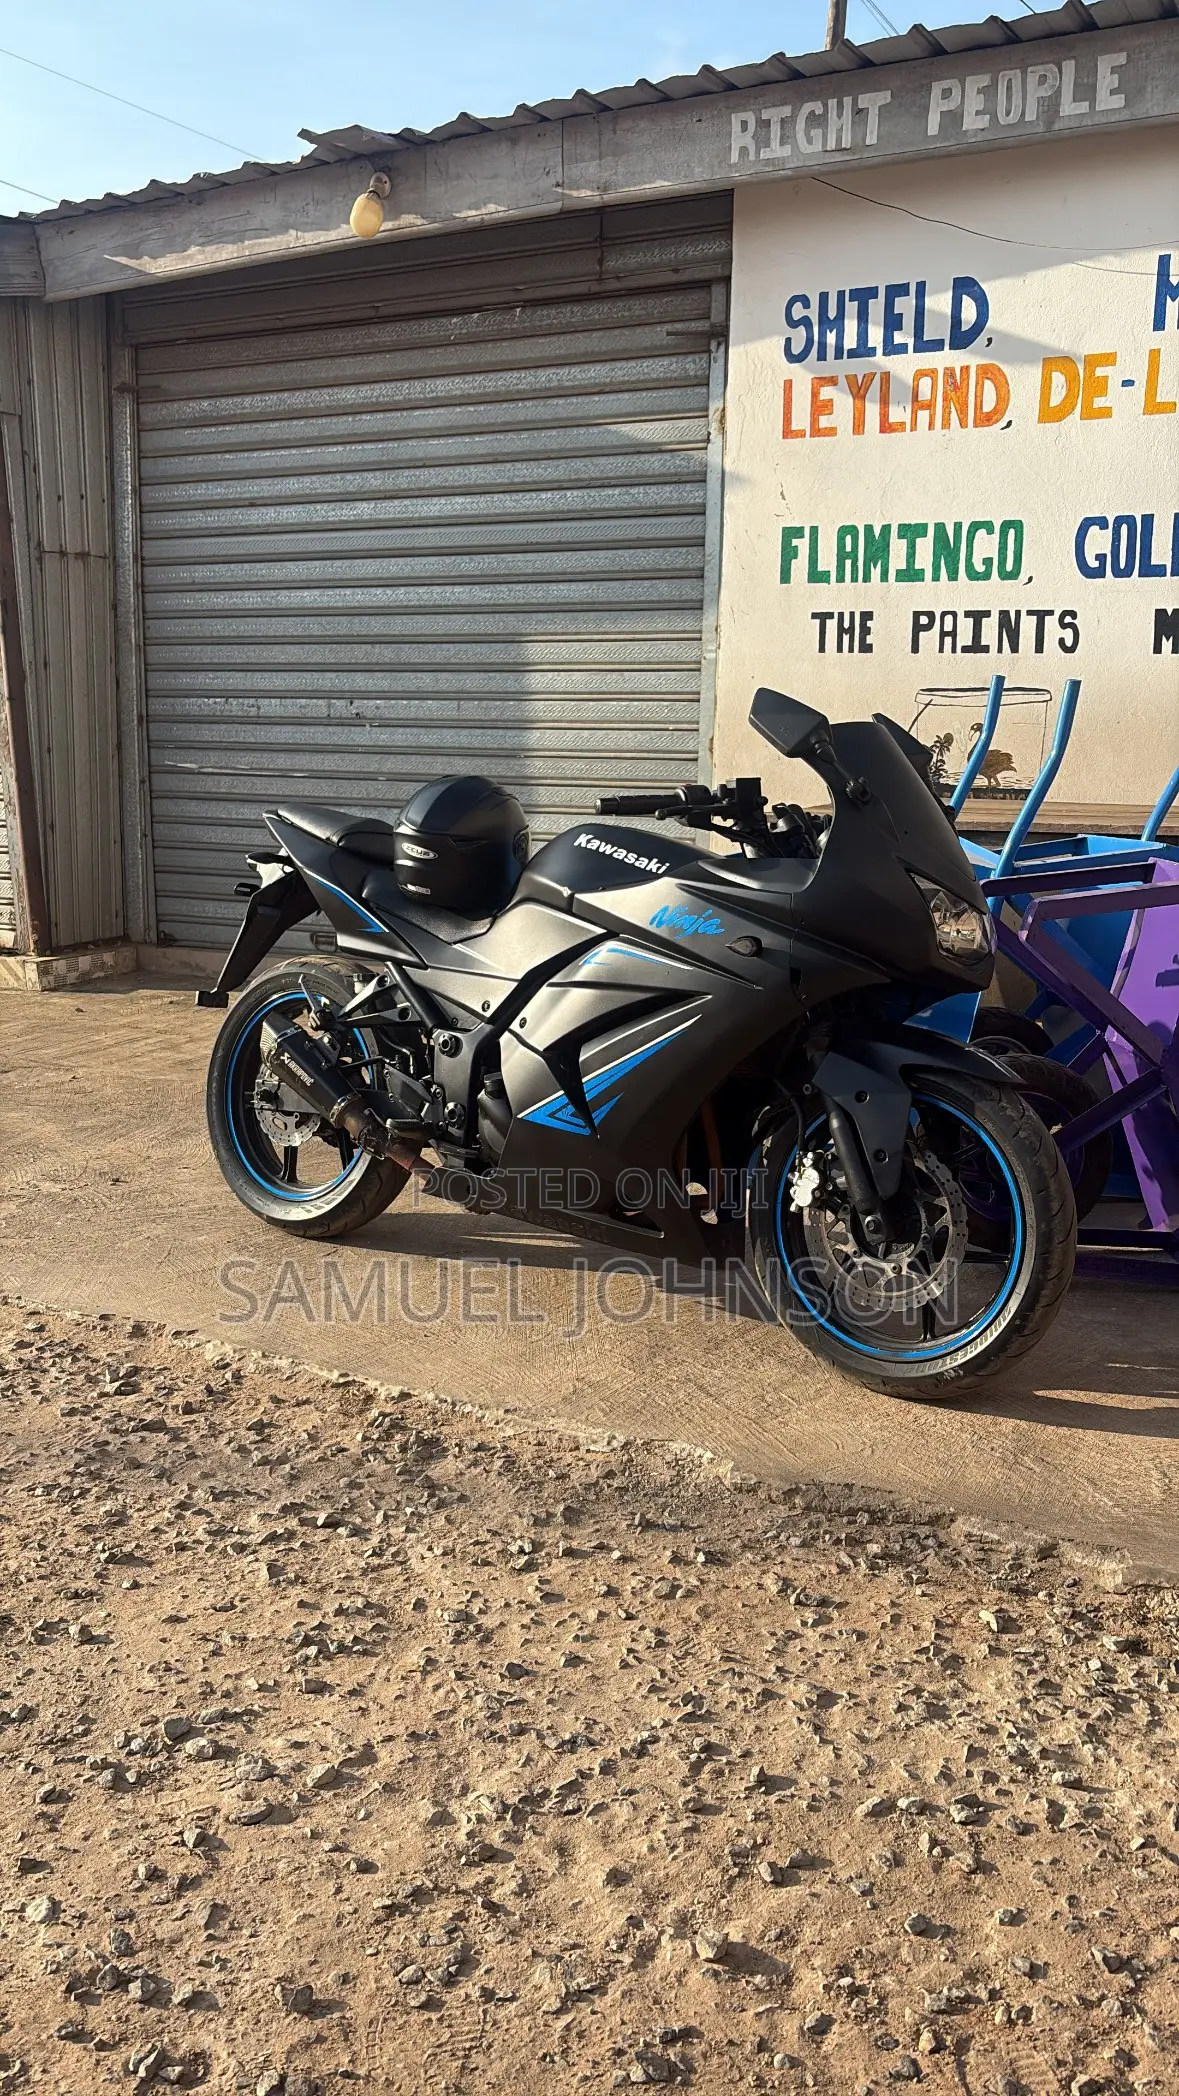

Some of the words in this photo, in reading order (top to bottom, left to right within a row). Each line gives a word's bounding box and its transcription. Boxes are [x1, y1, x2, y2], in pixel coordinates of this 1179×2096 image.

[730, 90, 892, 164] RIGHT
[927, 52, 1127, 136] PEOPLE
[784, 276, 993, 364] SHIELD,
[782, 363, 1013, 439] LEYLAND,
[780, 519, 1034, 586] FLAMINGO,
[1074, 512, 1179, 579] GOL
[811, 611, 874, 654] THE
[910, 609, 1080, 654] PAINTS
[573, 833, 670, 874] Kawasaki
[649, 904, 725, 939] Ninja
